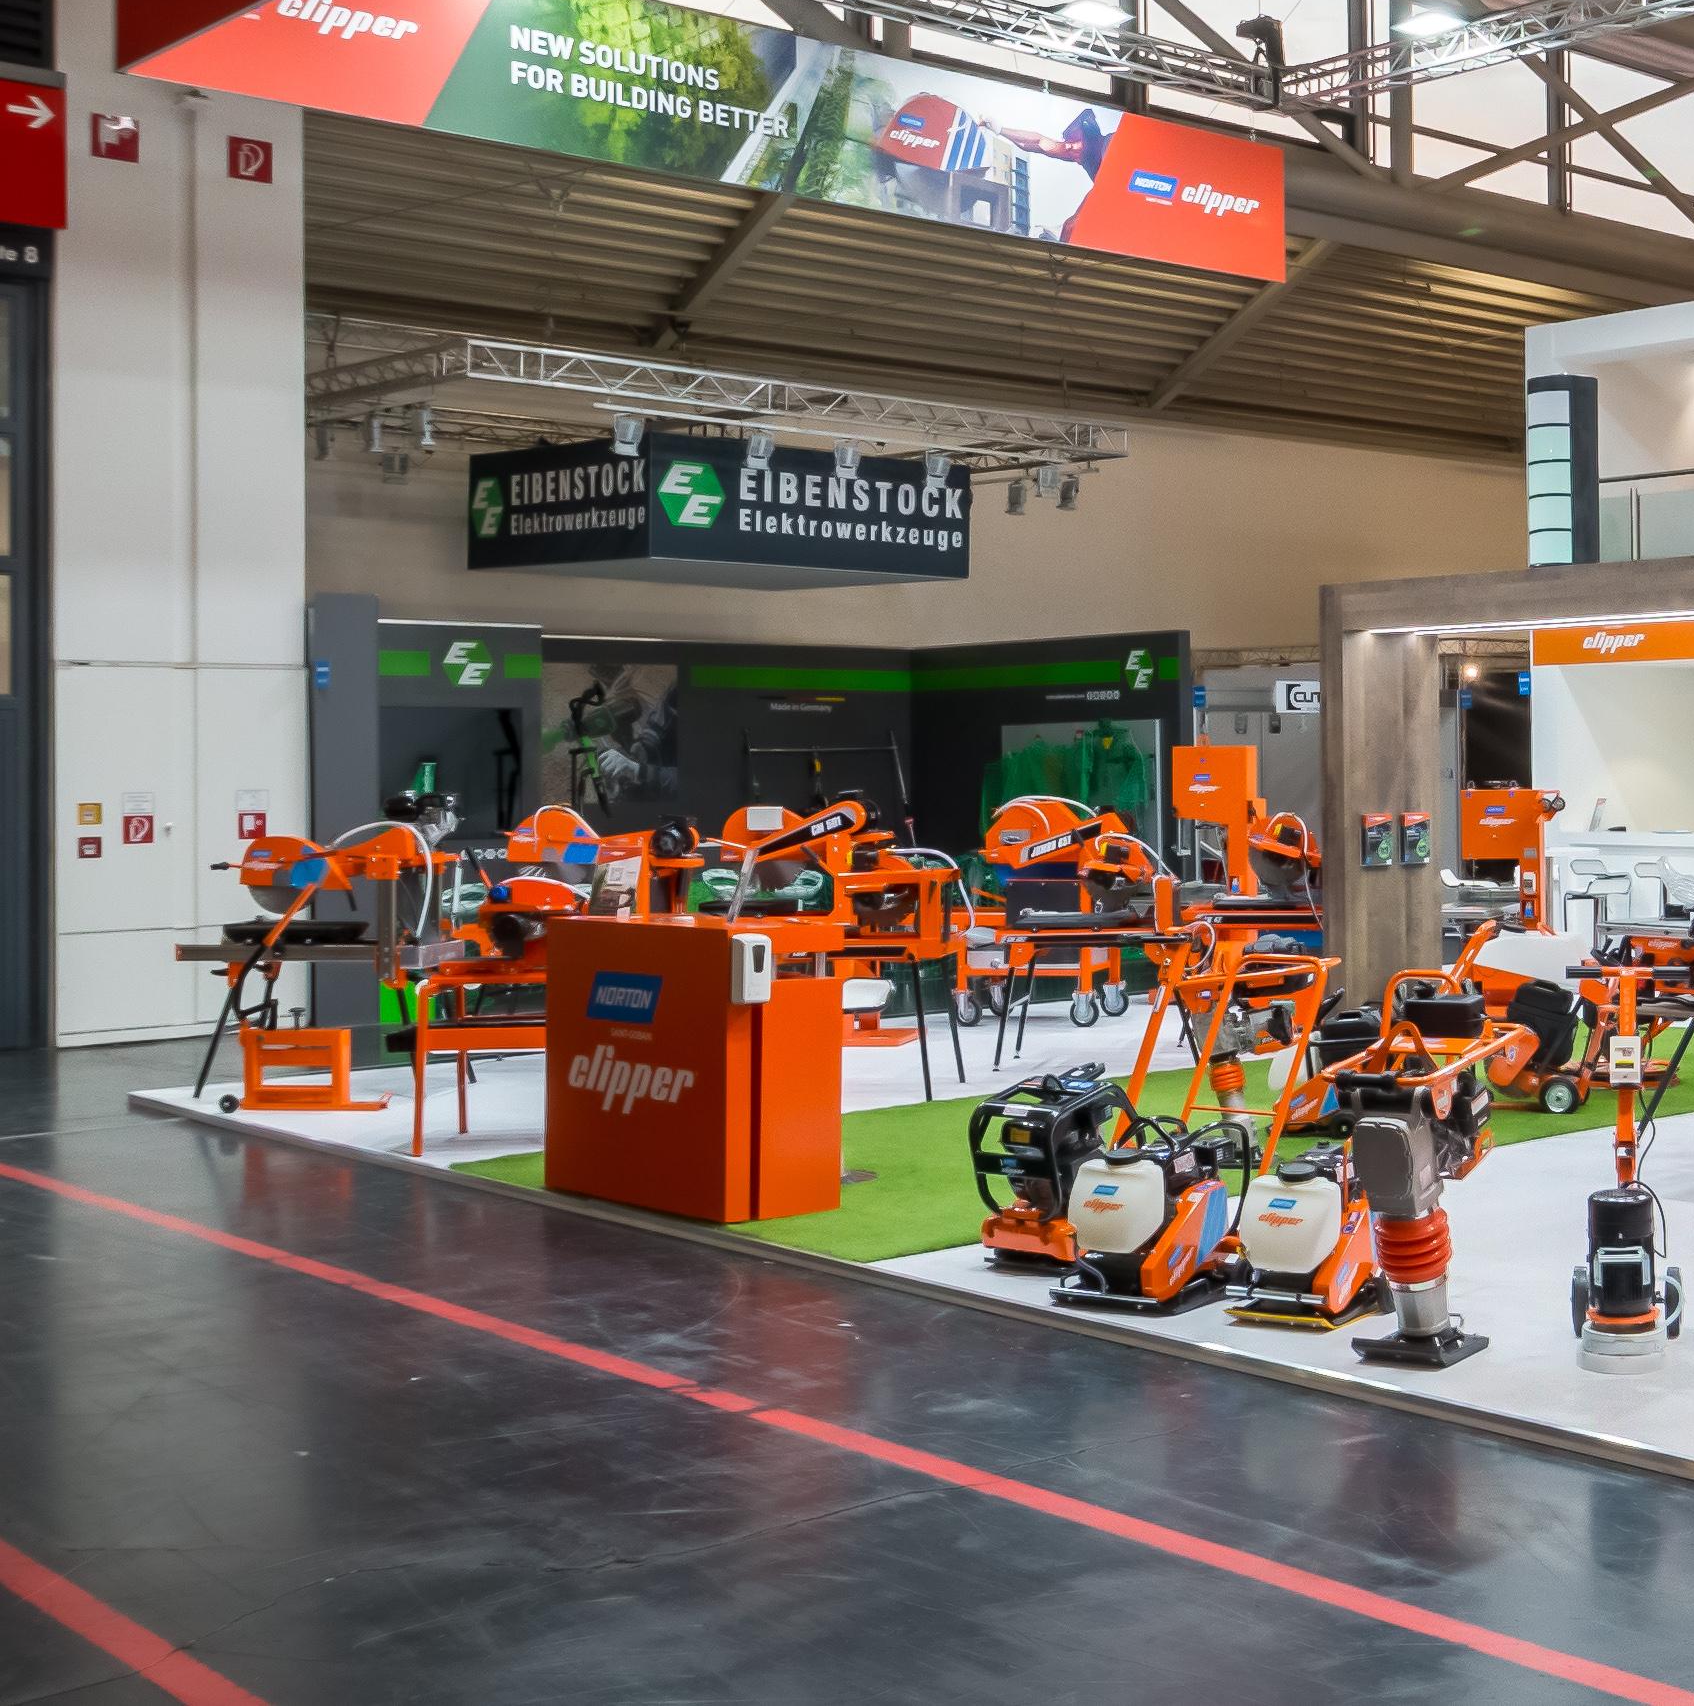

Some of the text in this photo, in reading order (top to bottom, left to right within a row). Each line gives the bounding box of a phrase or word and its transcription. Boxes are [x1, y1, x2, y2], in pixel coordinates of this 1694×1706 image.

[510, 26, 720, 92] NEW SOLUTIONS
[510, 61, 789, 139] FOR BUILDING BETTER
[1181, 183, 1260, 216] clipper
[511, 459, 646, 506] EIBENSTOCK
[740, 468, 963, 519] EIBENSTOCK
[511, 506, 646, 536] Elektrowerkzeuge
[739, 510, 963, 551] Elektrowerkzeuge
[1583, 632, 1645, 654] clipper
[593, 985, 653, 1010] NORTON
[568, 1044, 694, 1115] clipper
